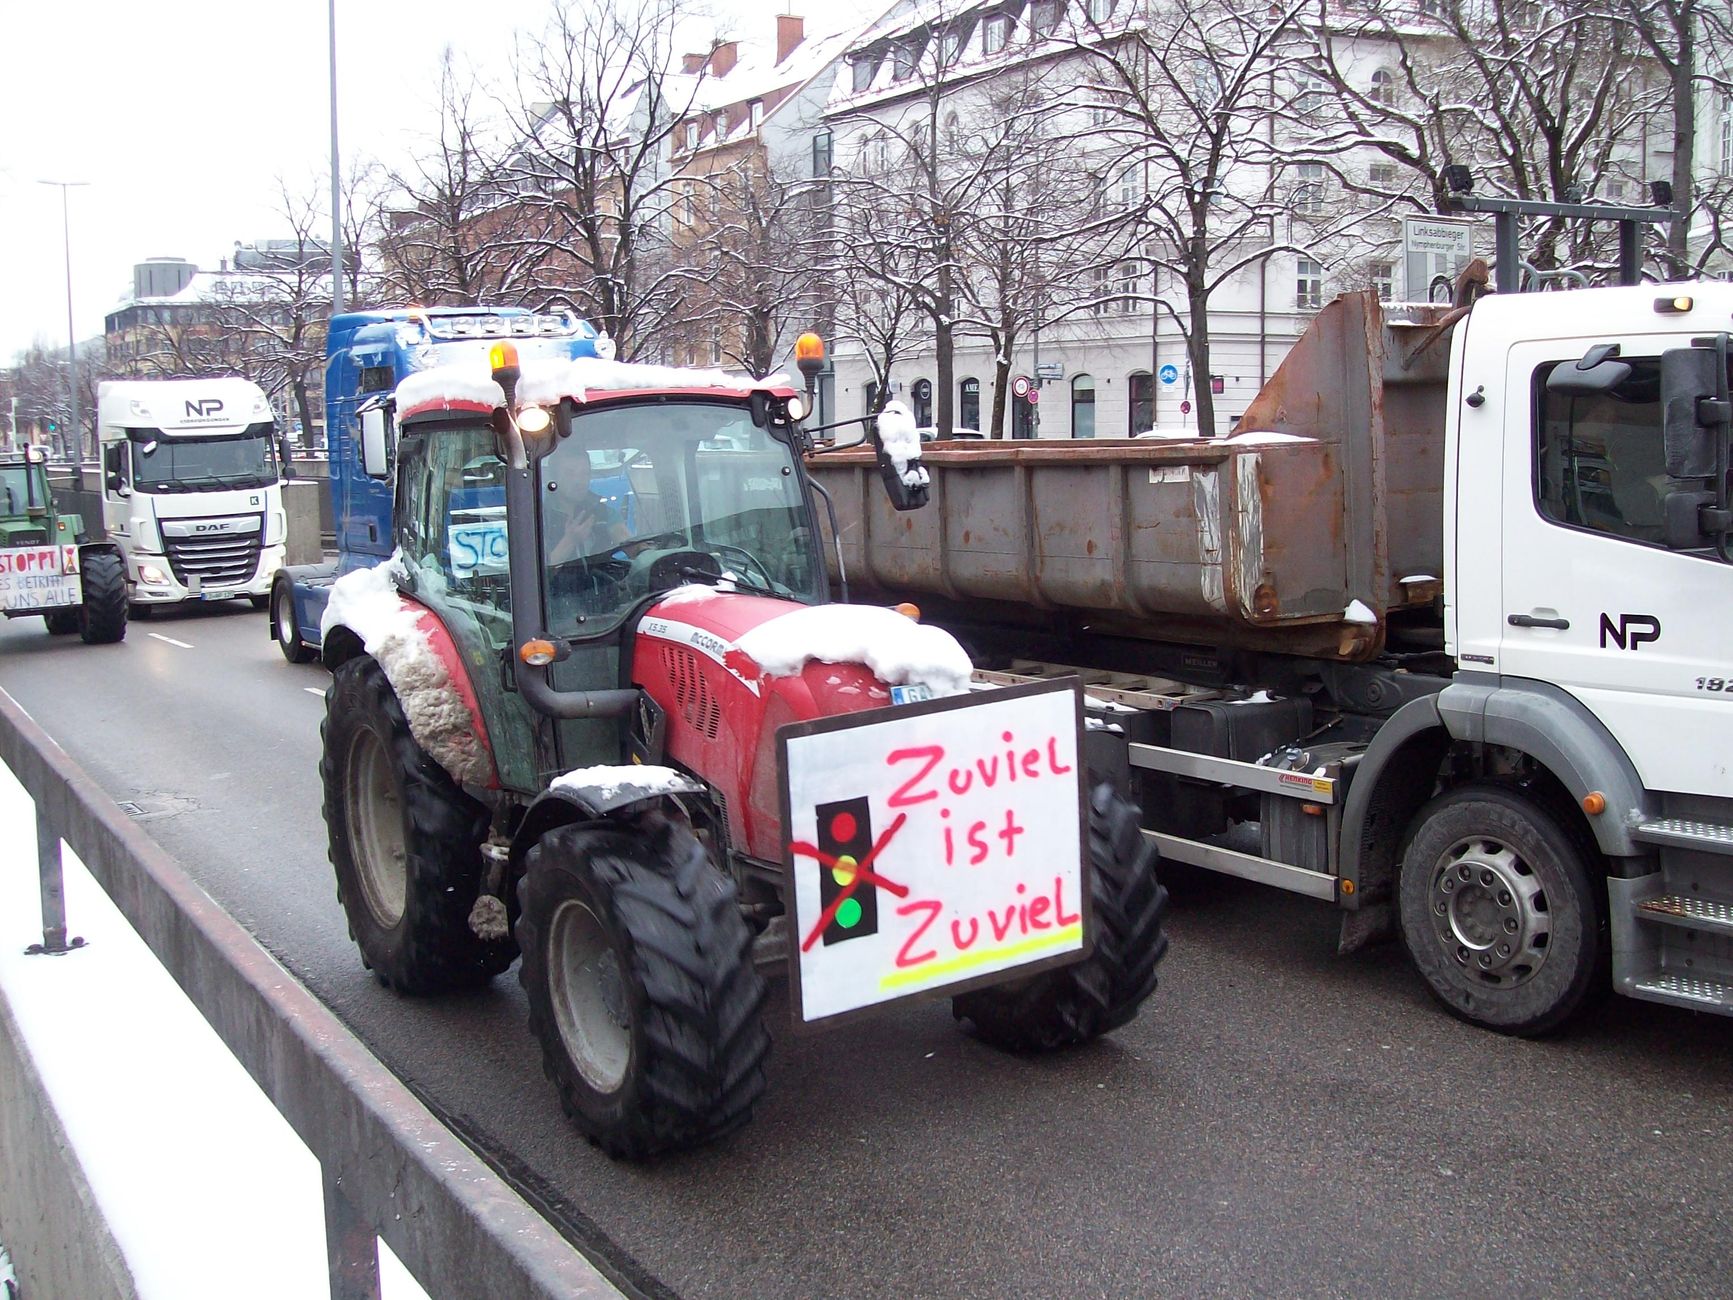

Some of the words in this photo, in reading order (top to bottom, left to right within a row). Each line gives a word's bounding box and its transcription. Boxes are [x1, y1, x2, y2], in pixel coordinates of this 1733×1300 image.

[1413, 225, 1464, 241] Linksabbieger
[185, 399, 224, 417] NP
[195, 523, 230, 532] DAF
[45, 587, 77, 605] ALLE
[1599, 612, 1661, 650] NP
[941, 808, 1024, 866] ist
